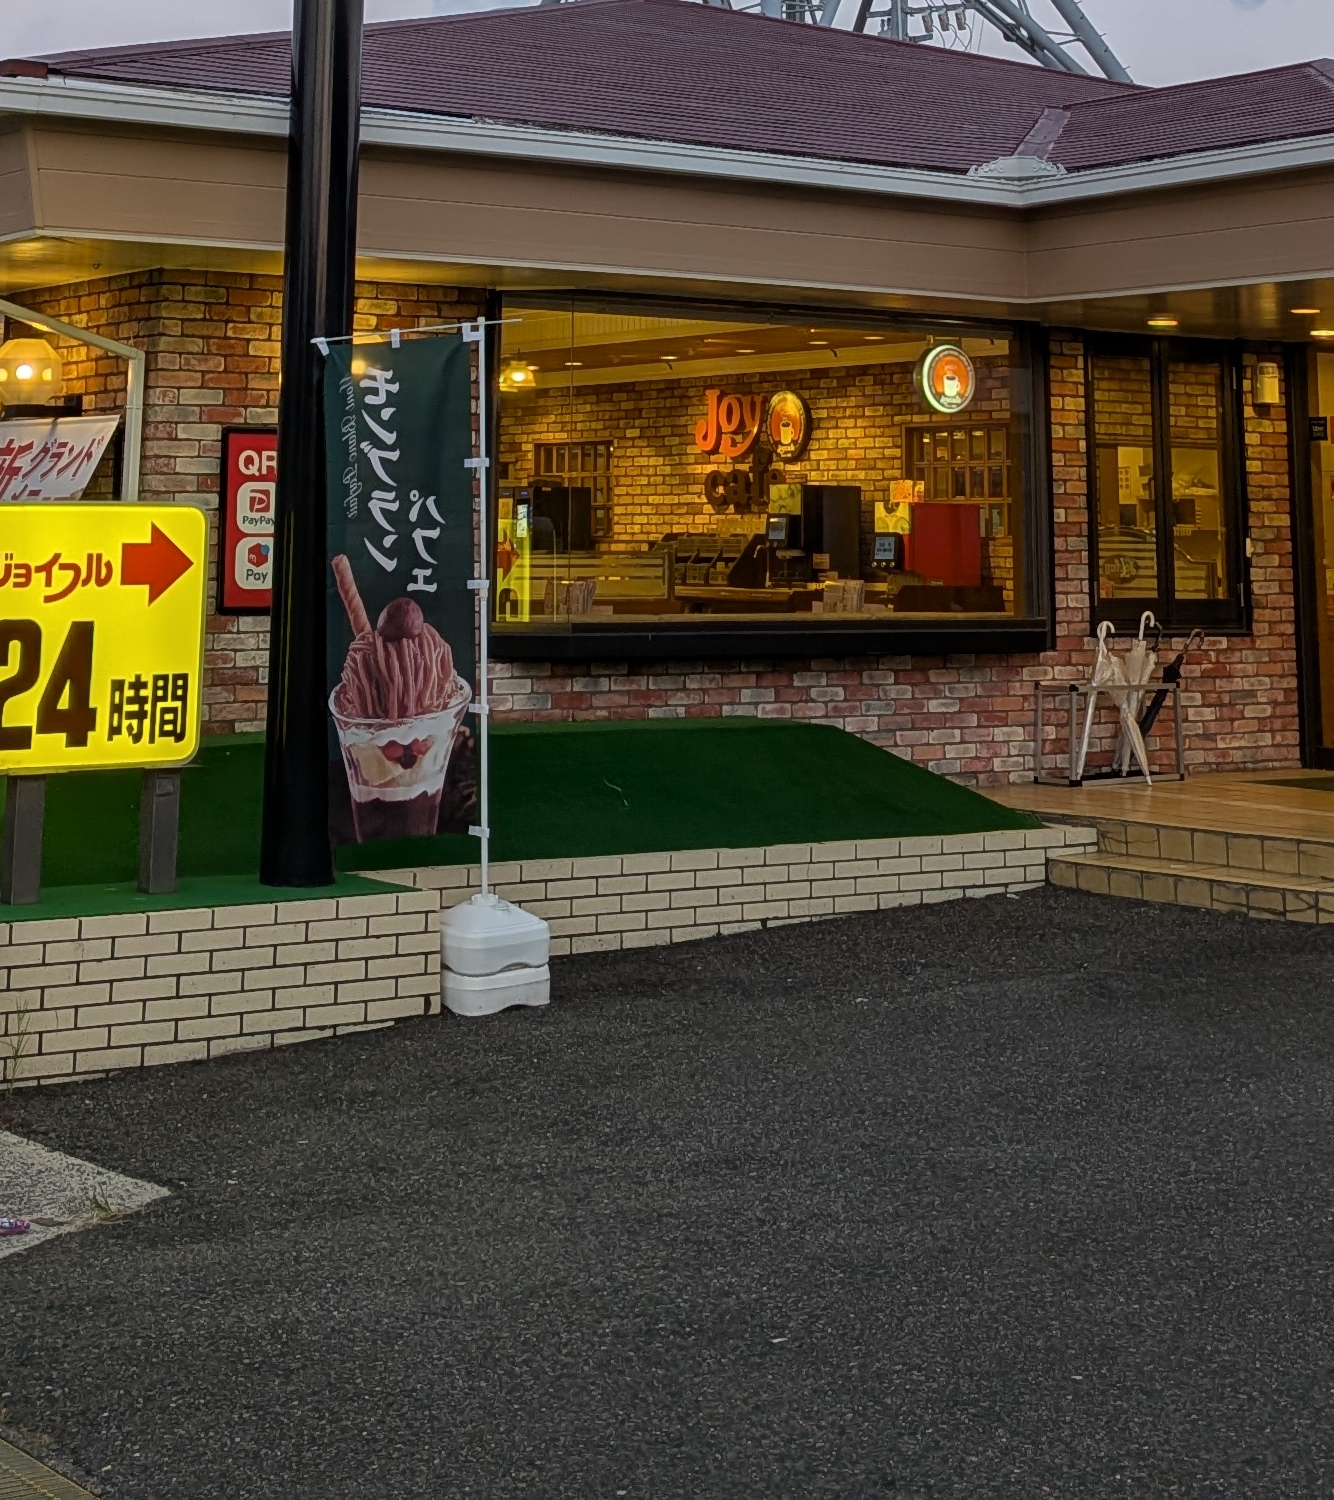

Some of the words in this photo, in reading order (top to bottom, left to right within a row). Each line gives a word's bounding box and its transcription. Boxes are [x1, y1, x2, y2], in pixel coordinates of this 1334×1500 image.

[695, 389, 764, 457] Joy
[22, 436, 104, 482] グランド
[238, 450, 277, 476] QR
[242, 515, 276, 528] PayPay
[245, 568, 269, 584] Pay
